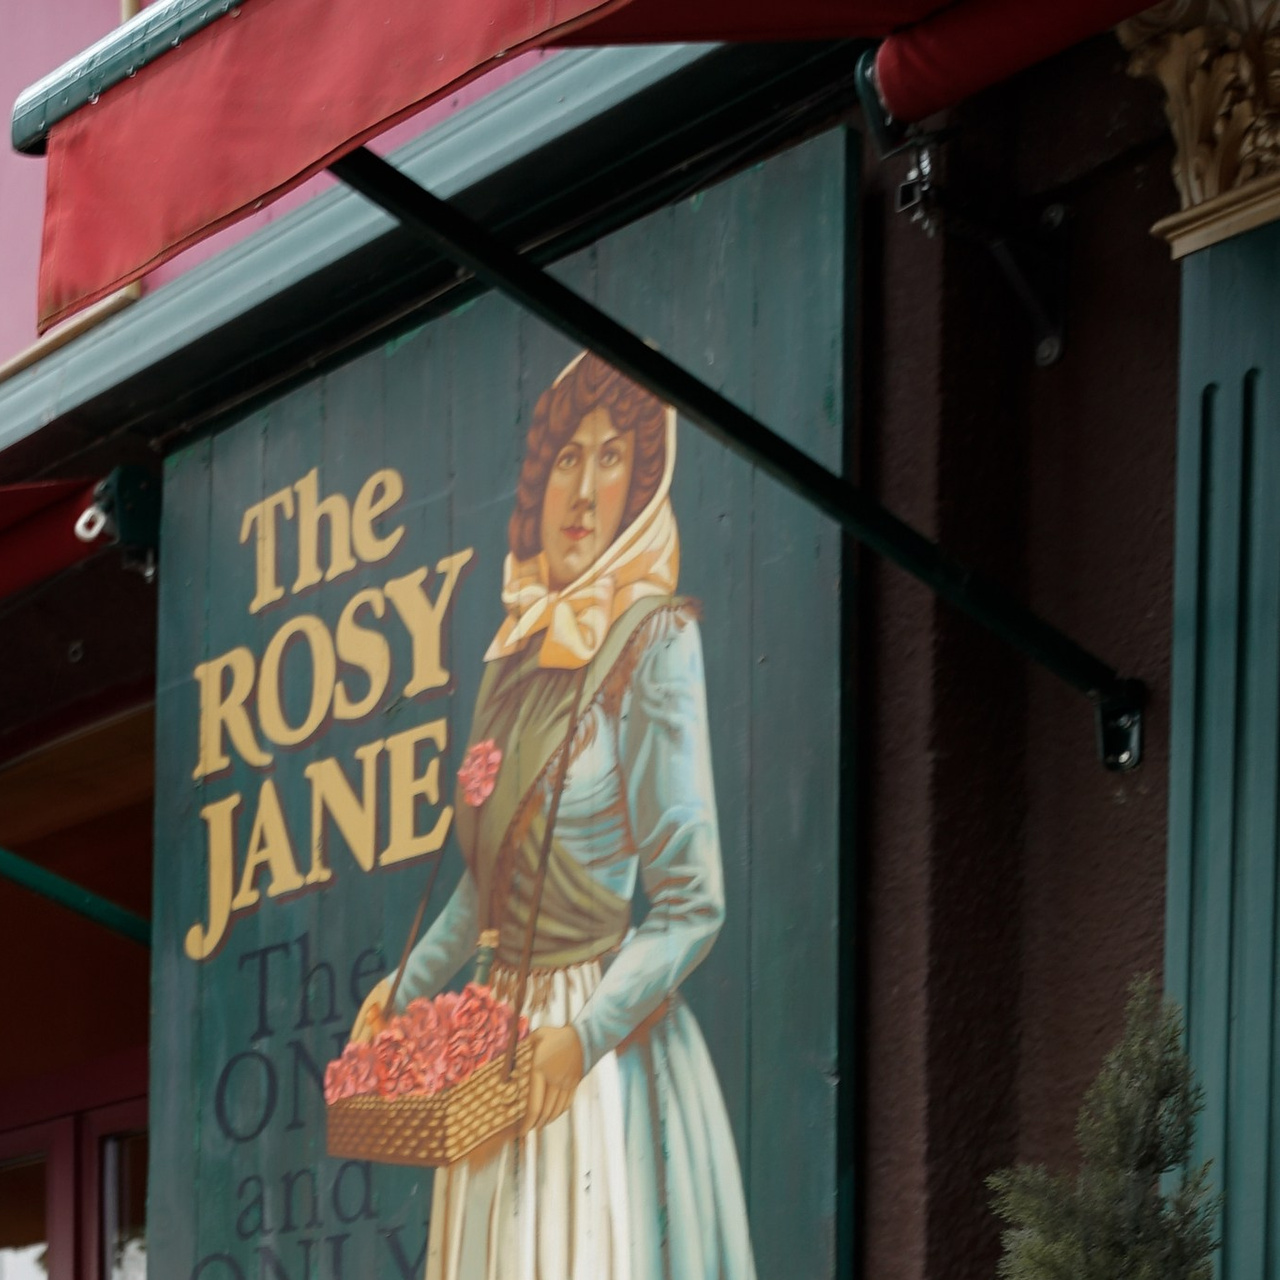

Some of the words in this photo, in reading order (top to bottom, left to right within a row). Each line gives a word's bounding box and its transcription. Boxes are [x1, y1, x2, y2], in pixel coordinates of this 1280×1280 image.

[239, 467, 406, 615] The
[193, 546, 475, 781] ROSY
[185, 717, 455, 962] JANE
[238, 932, 388, 1043] The
[215, 1031, 352, 1144] ON
[236, 1159, 380, 1241] and
